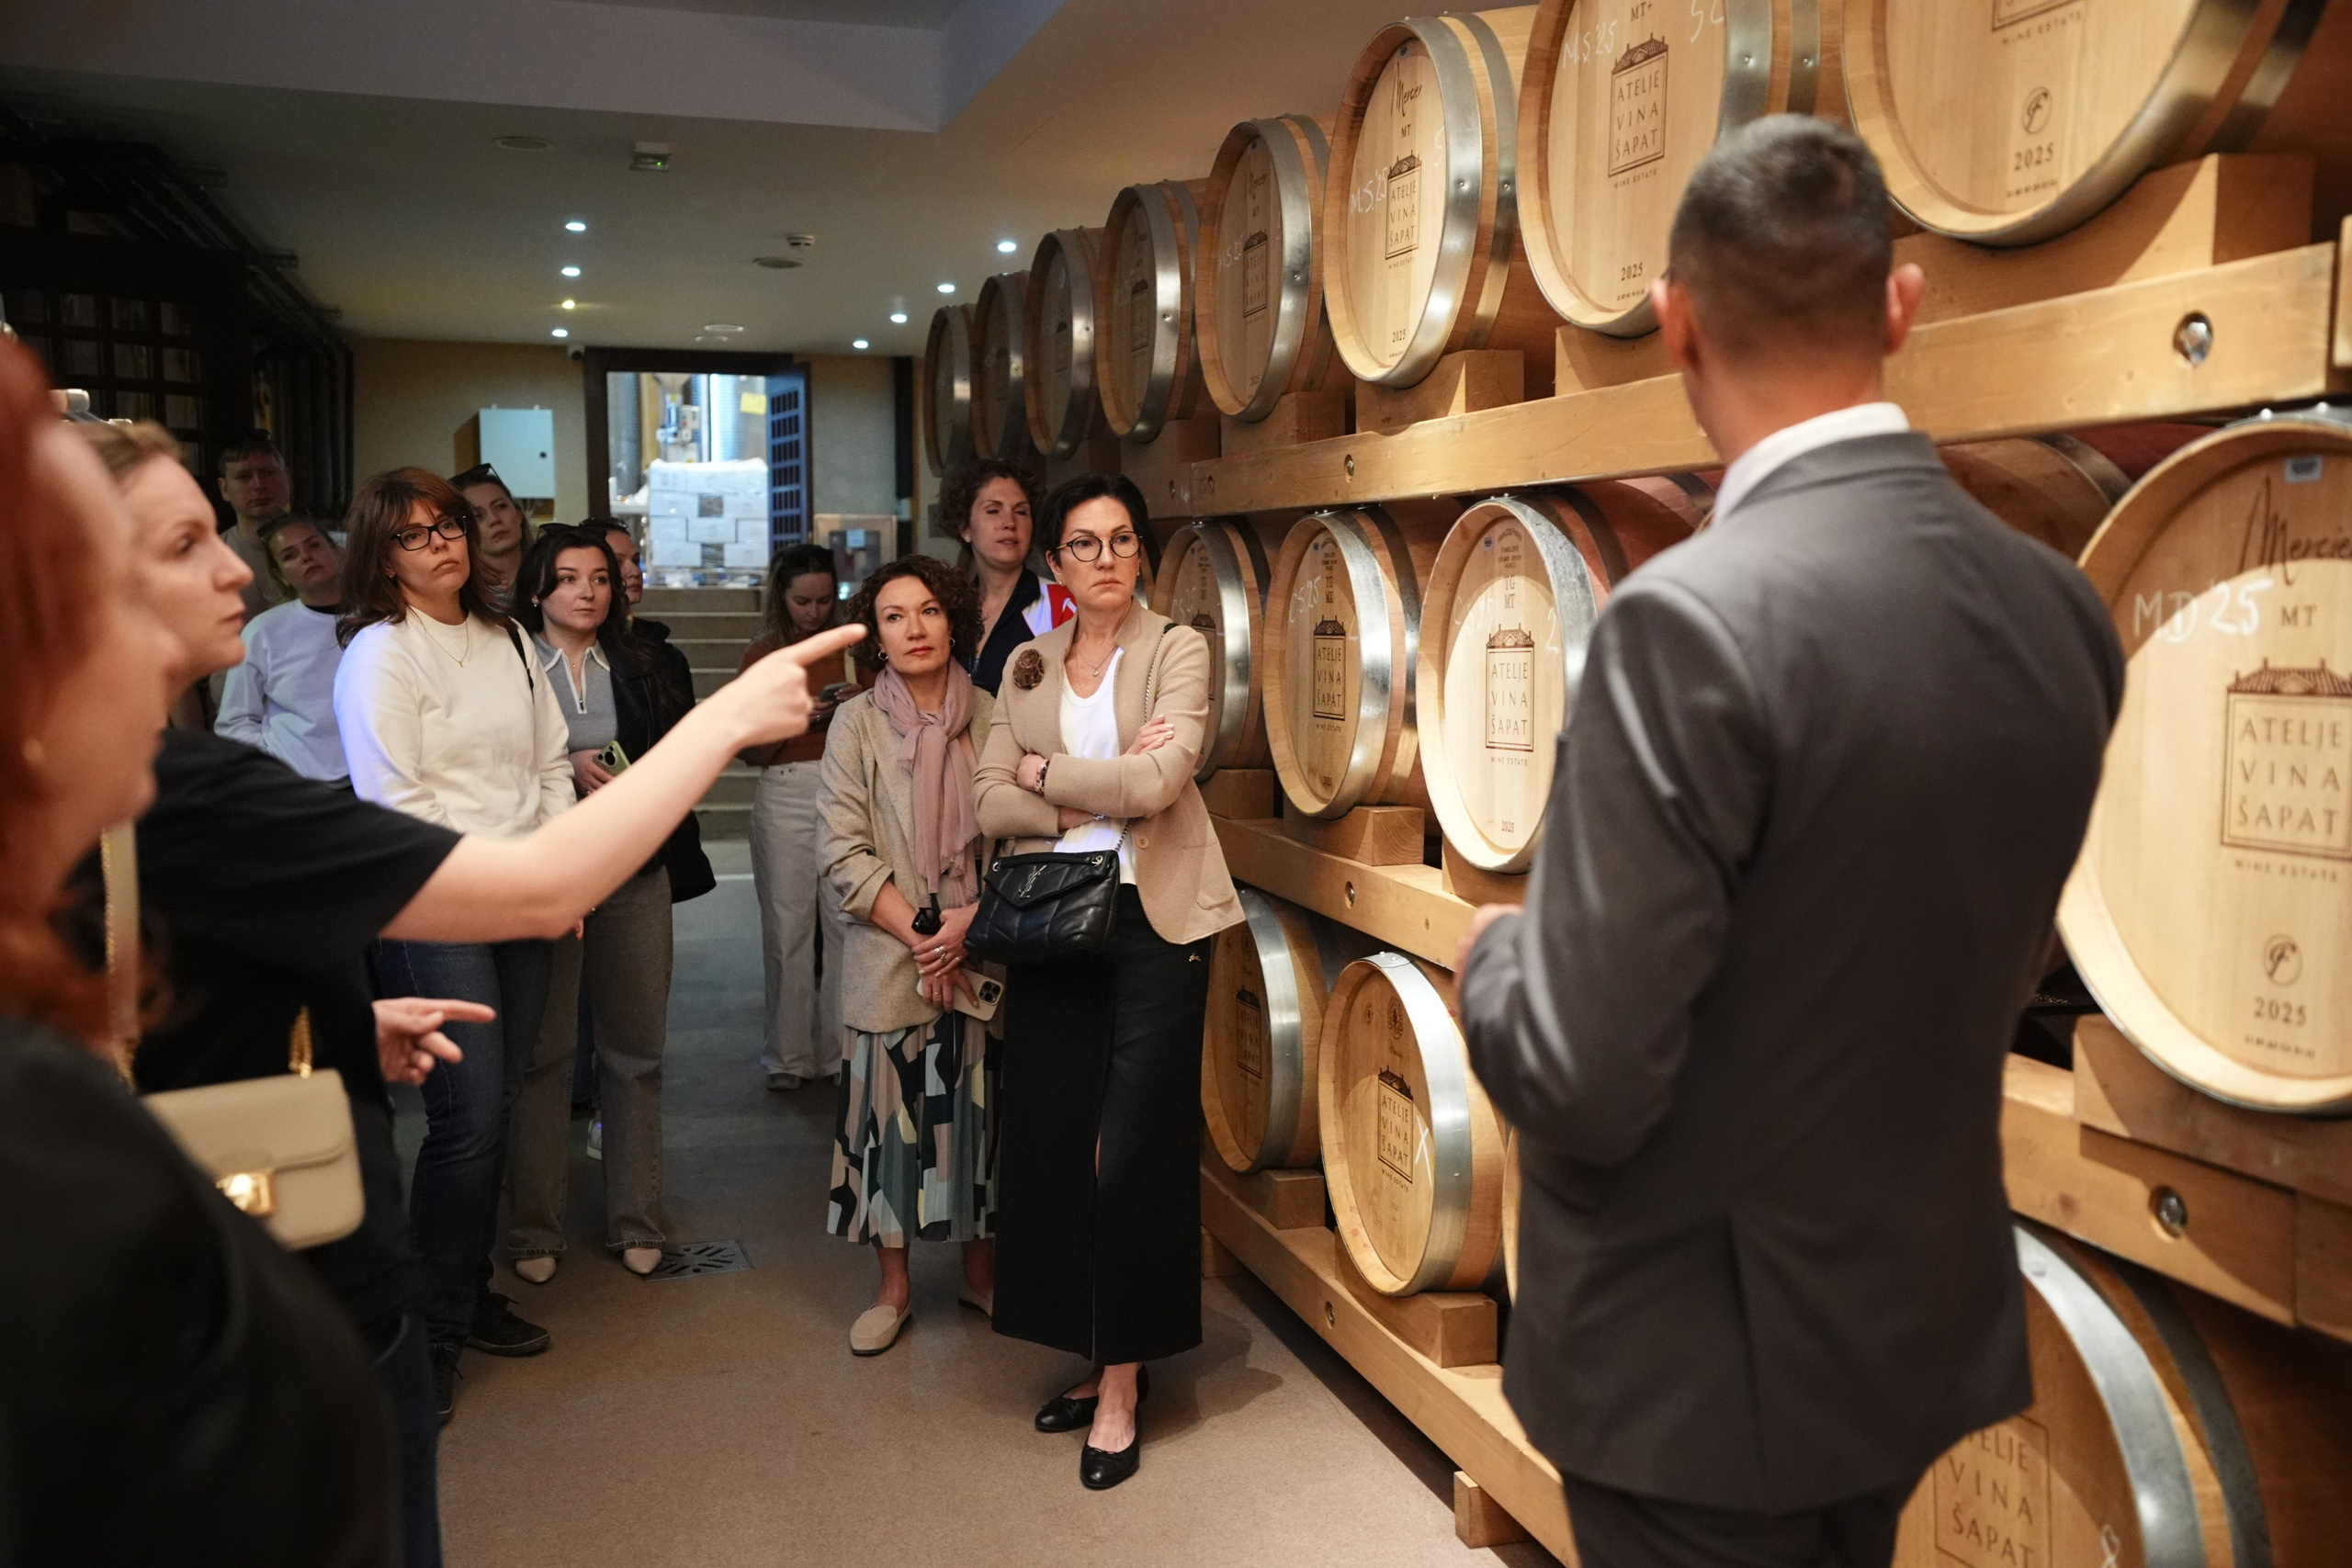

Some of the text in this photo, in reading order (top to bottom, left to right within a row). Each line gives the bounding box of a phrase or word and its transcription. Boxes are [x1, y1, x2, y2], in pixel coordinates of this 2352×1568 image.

[1390, 62, 1423, 118] Mercier
[1617, 70, 1660, 103] ATELJE
[1617, 101, 1658, 130] VINA
[1401, 124, 1411, 139] MT
[1615, 129, 1658, 160] ŠAPAT
[2013, 142, 2054, 171] 2025
[1633, 168, 1657, 183] ESTATE
[1391, 180, 1417, 202] ATELJE
[1390, 204, 1416, 223] VINA
[1389, 225, 1415, 247] ŠAPAT
[1621, 262, 1644, 281] 2025
[1392, 329, 1407, 343] 2025
[1504, 574, 1515, 591] TG
[1504, 592, 1516, 609] MT
[2281, 604, 2317, 626] MT
[1317, 647, 1342, 663] ATELJE
[1317, 670, 1341, 685] VINA
[1491, 662, 1528, 682] ATELJE
[1317, 689, 1341, 708] ŠAPAT
[1491, 690, 1528, 707] VINA
[1491, 714, 1527, 736] ŠAPAT
[2240, 716, 2344, 753] ATELJE
[1490, 756, 1529, 767] WINE ESTATE
[2240, 758, 2341, 793] VINA
[2237, 794, 2339, 836] ŠAPAT
[1501, 820, 1515, 833] 2025
[2278, 863, 2339, 883] ESTATE
[2254, 996, 2308, 1027] 2025
[1382, 1094, 1409, 1123] ATELJE
[1382, 1115, 1409, 1145] VINA
[1382, 1134, 1409, 1168] ŠAPAT
[1948, 1454, 2033, 1526] VINA
